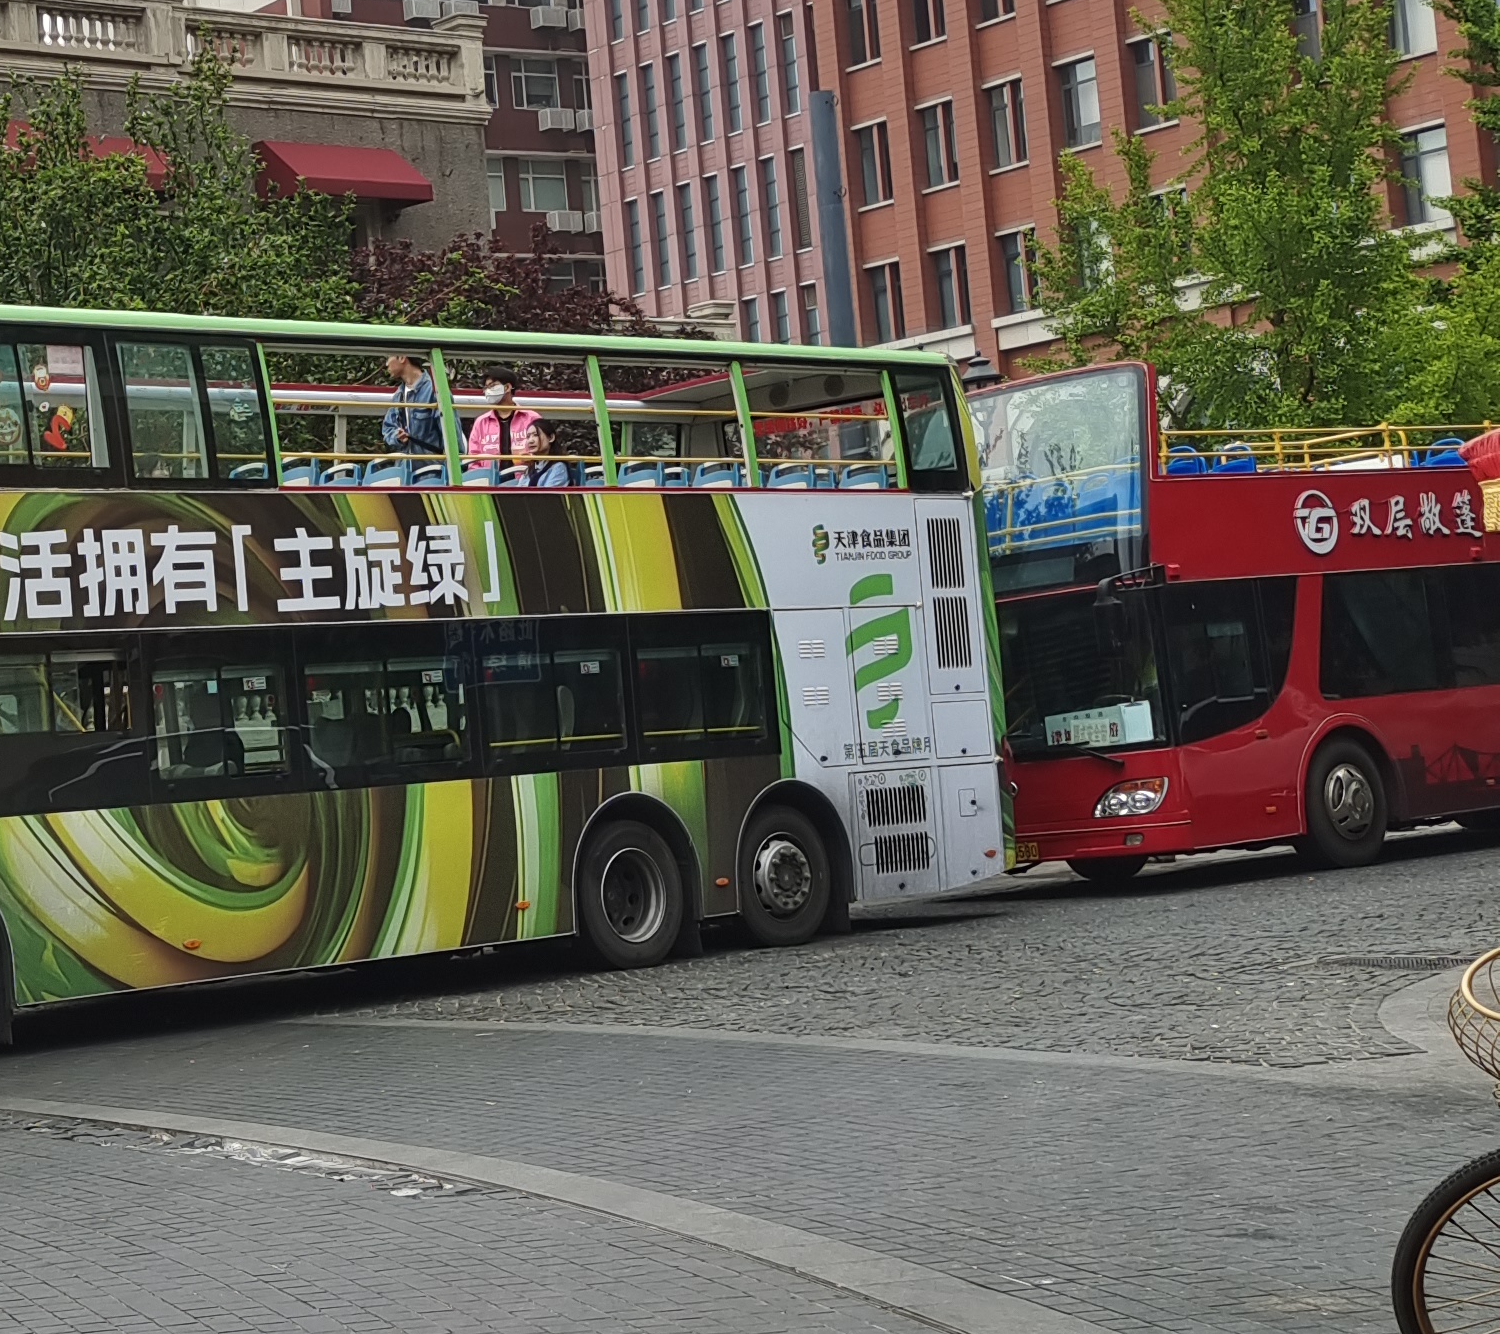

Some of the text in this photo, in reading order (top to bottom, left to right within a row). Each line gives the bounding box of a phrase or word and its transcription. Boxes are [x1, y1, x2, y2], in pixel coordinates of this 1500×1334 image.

[1350, 490, 1483, 540] 双层敞篷
[833, 529, 911, 549] 天津食品集团
[835, 550, 912, 561] TIANJIN FOOD GROUP
